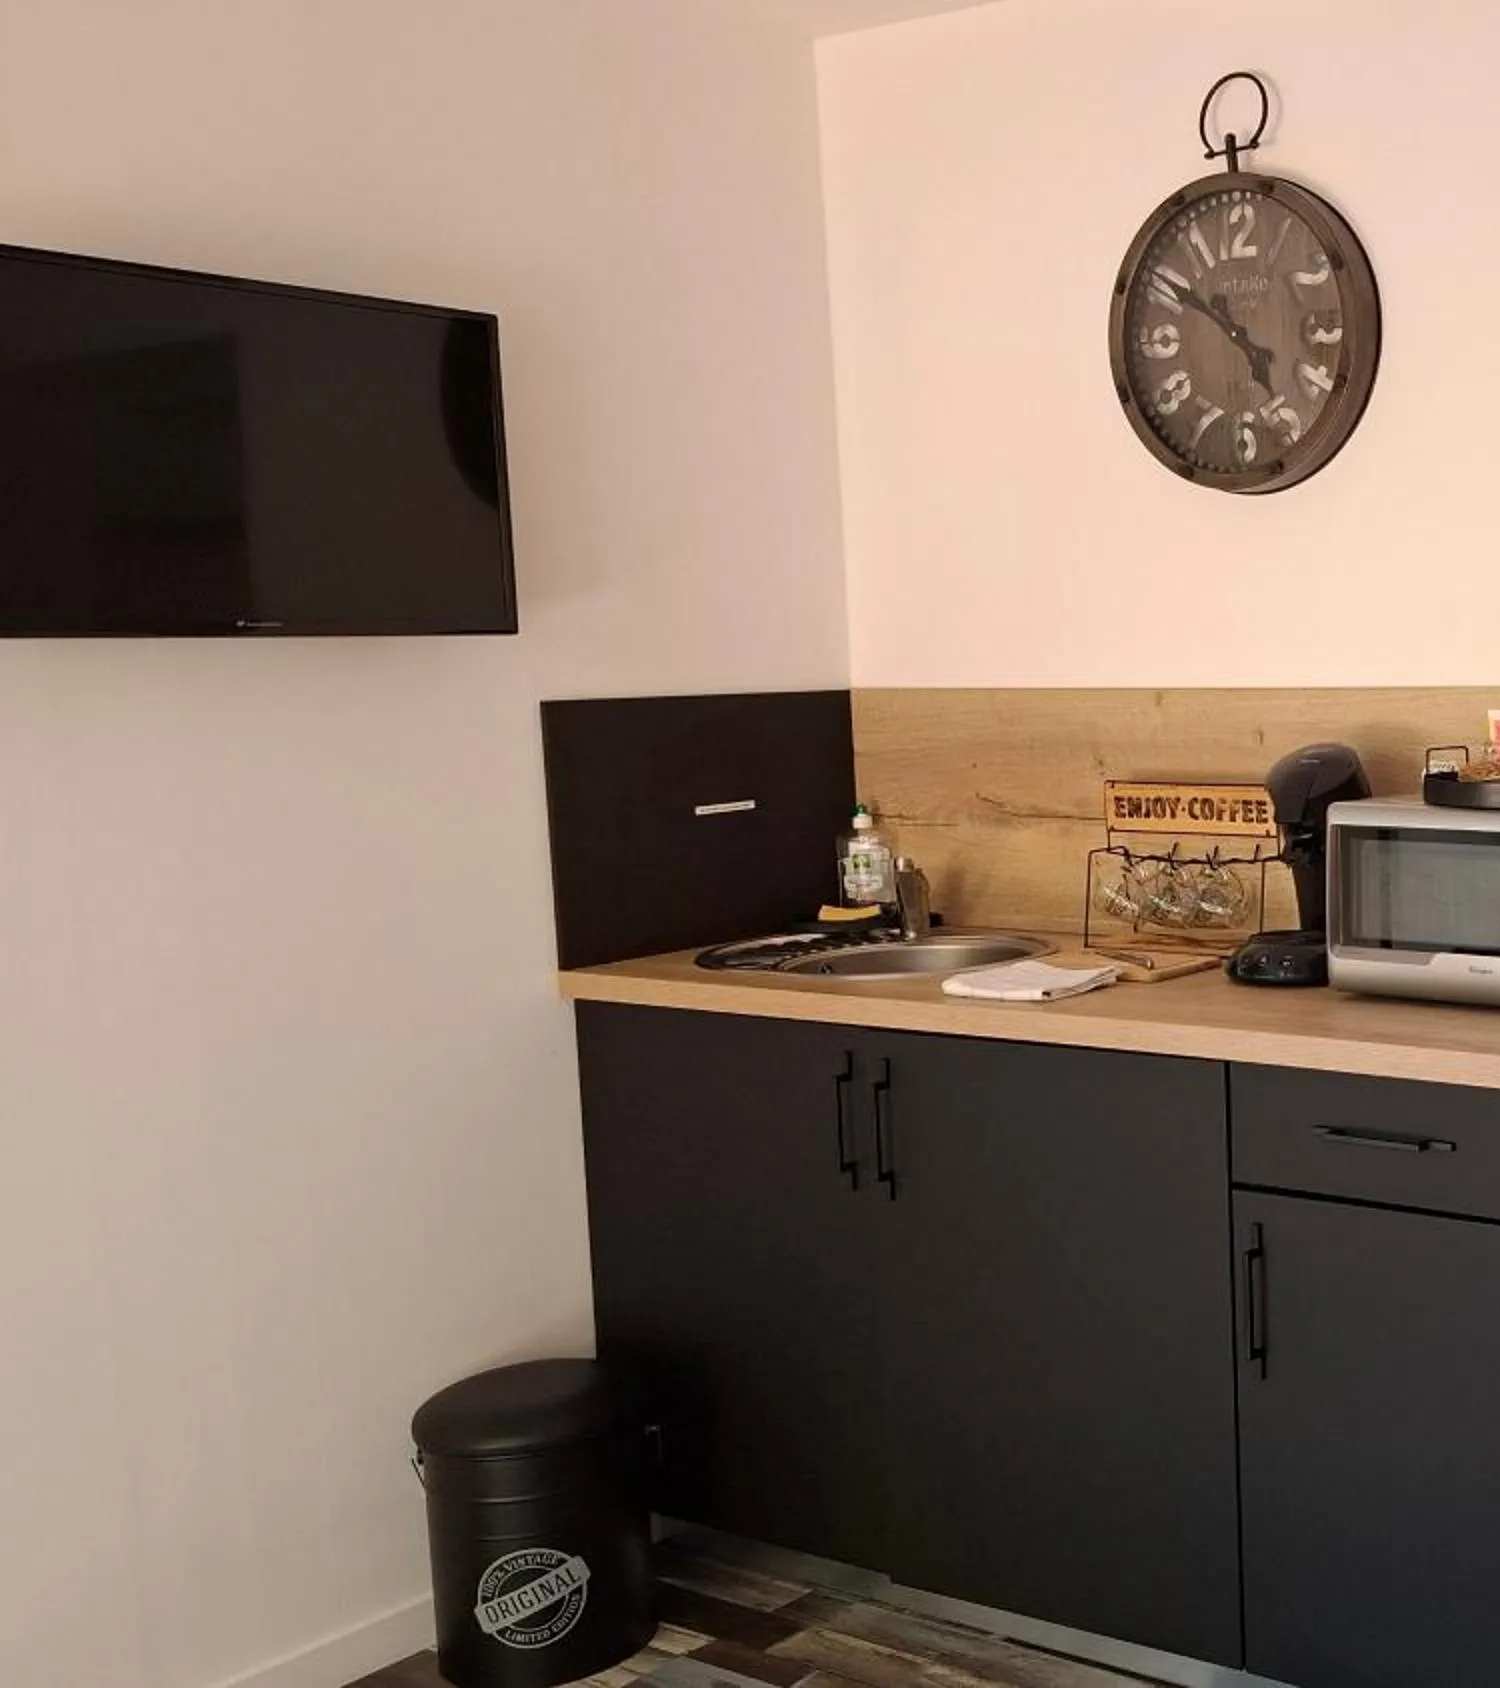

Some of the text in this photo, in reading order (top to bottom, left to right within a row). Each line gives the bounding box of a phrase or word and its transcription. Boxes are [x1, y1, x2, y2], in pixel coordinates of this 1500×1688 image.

[1219, 203, 1259, 261] 12
[1234, 410, 1258, 463] 6
[1113, 795, 1269, 825] ENJOY COFFEE
[484, 1567, 582, 1624] ORIGINAL
[504, 1629, 552, 1643] LIMITED
